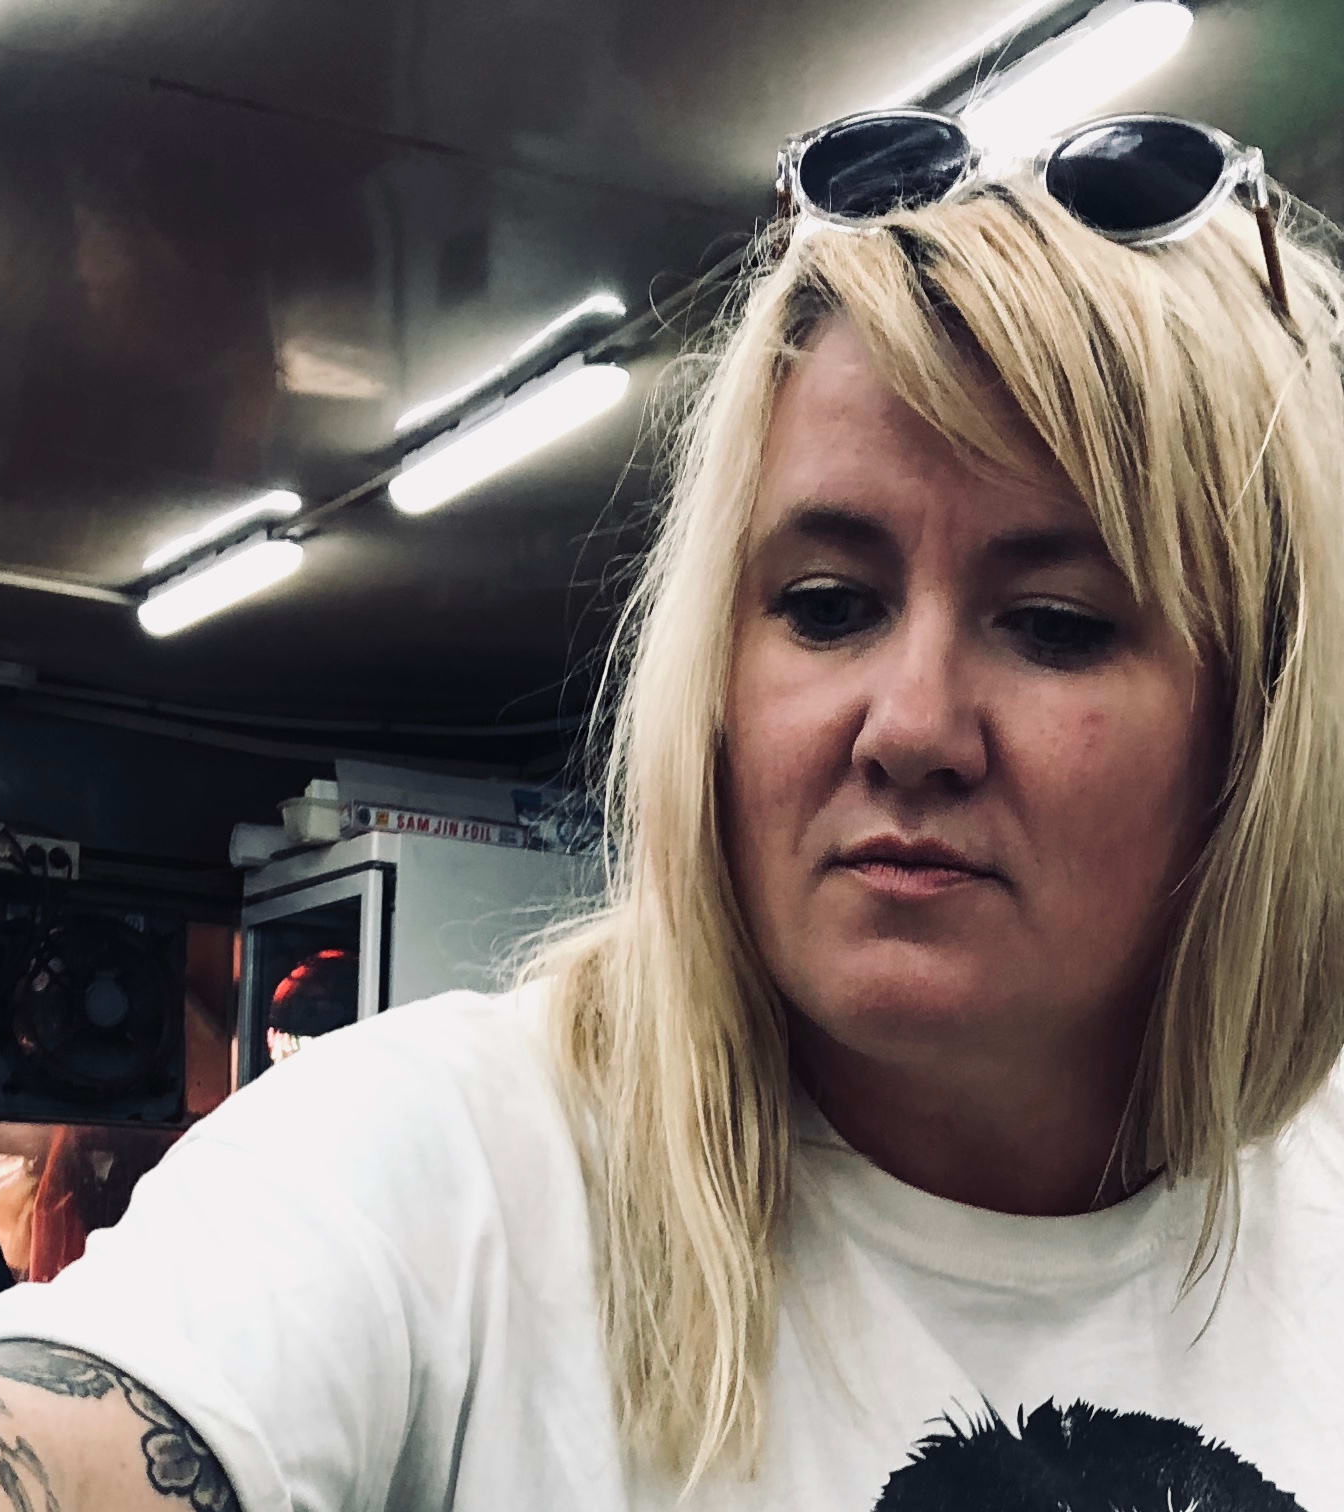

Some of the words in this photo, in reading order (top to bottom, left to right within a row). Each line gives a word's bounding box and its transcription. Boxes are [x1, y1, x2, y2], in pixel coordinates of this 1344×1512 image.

[397, 813, 429, 832] SAM
[434, 820, 458, 837] JIN
[463, 824, 491, 841] FOIL
